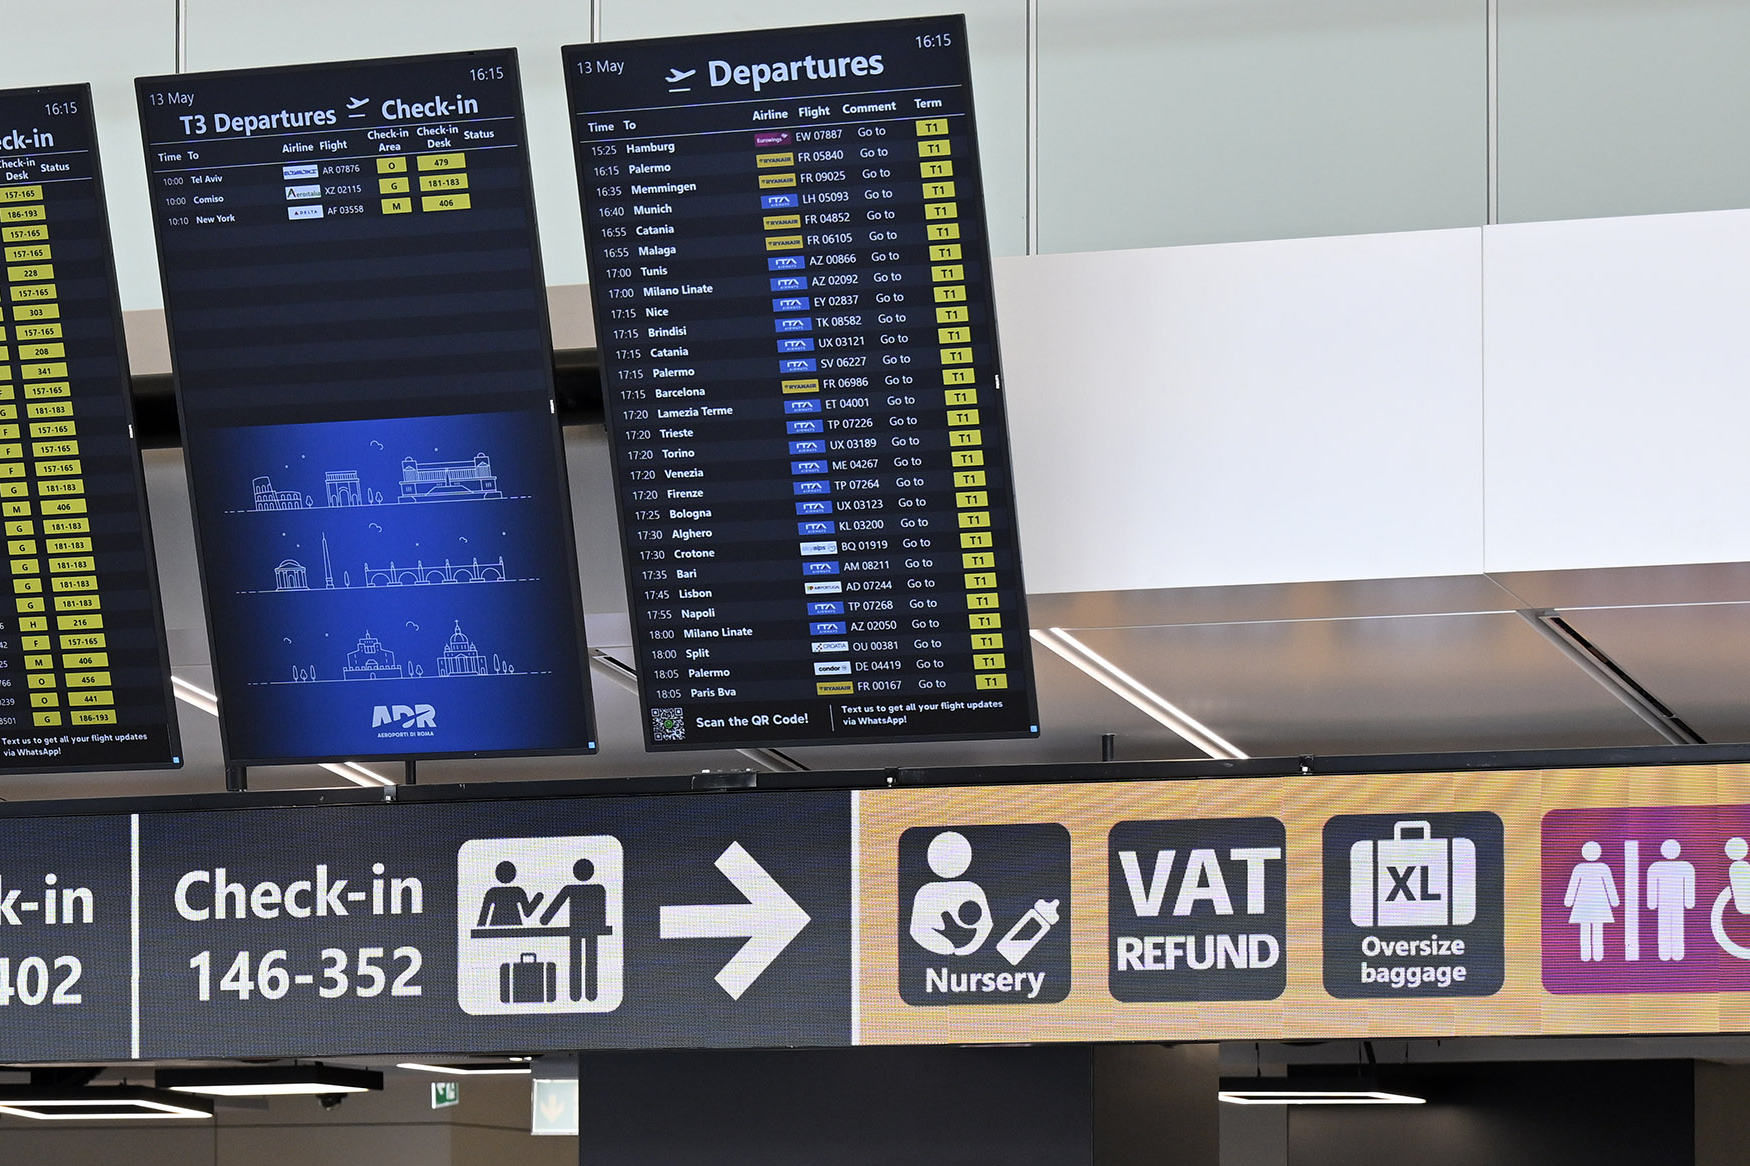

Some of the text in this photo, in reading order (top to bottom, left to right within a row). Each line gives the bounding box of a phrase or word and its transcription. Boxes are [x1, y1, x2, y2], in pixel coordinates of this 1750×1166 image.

[915, 33, 952, 49] 16:15
[469, 66, 504, 82] 16:15
[577, 59, 625, 76] 13 May
[709, 55, 884, 91] Departures
[44, 101, 78, 116] 16:15
[149, 91, 195, 107] 13 May
[178, 94, 478, 136] T3 Departures Check-in
[587, 98, 943, 133] Time To Airline Flight Comment Term
[366, 127, 410, 140] Check-in
[416, 124, 459, 137] Check-in
[427, 137, 452, 149] Desk
[463, 130, 495, 140] Status
[591, 144, 618, 156] 15:25
[626, 142, 676, 154] Hamburg
[795, 131, 812, 142] EW
[813, 129, 843, 141] 07887
[857, 127, 873, 138] Go
[874, 126, 886, 136] to
[924, 122, 938, 133] T1
[378, 142, 401, 152] Area
[593, 165, 620, 177] 16:15
[628, 163, 672, 175] Palermo
[797, 152, 811, 163] FR
[812, 149, 844, 162] 05840
[859, 147, 876, 158] Go
[877, 147, 889, 157] to
[926, 143, 941, 154] T1
[163, 176, 184, 186] 10:00
[190, 175, 203, 184] Tel
[204, 174, 223, 183] Aviv
[322, 166, 335, 175] AR
[335, 164, 361, 174] 07876
[433, 158, 449, 167] 479
[596, 164, 943, 197] 16:35 Memmingen FR 09025 Go to T1
[4, 189, 36, 200] 157-165
[165, 177, 460, 206] 10:00 Comiso XZ 02115 G 181-183
[598, 191, 850, 218] 16:40 Munich LH 05093
[372, 704, 437, 728] ADR
[695, 712, 809, 728] Scan the QR Code!
[175, 862, 423, 921] Check-in
[1118, 847, 1282, 918] VAT
[1385, 866, 1441, 901] XL
[1116, 934, 1281, 971] REFUND
[1361, 933, 1466, 957] Oversize
[190, 946, 422, 1001] 146-352
[926, 968, 1045, 998] Nursery
[1361, 962, 1466, 988] baggage
